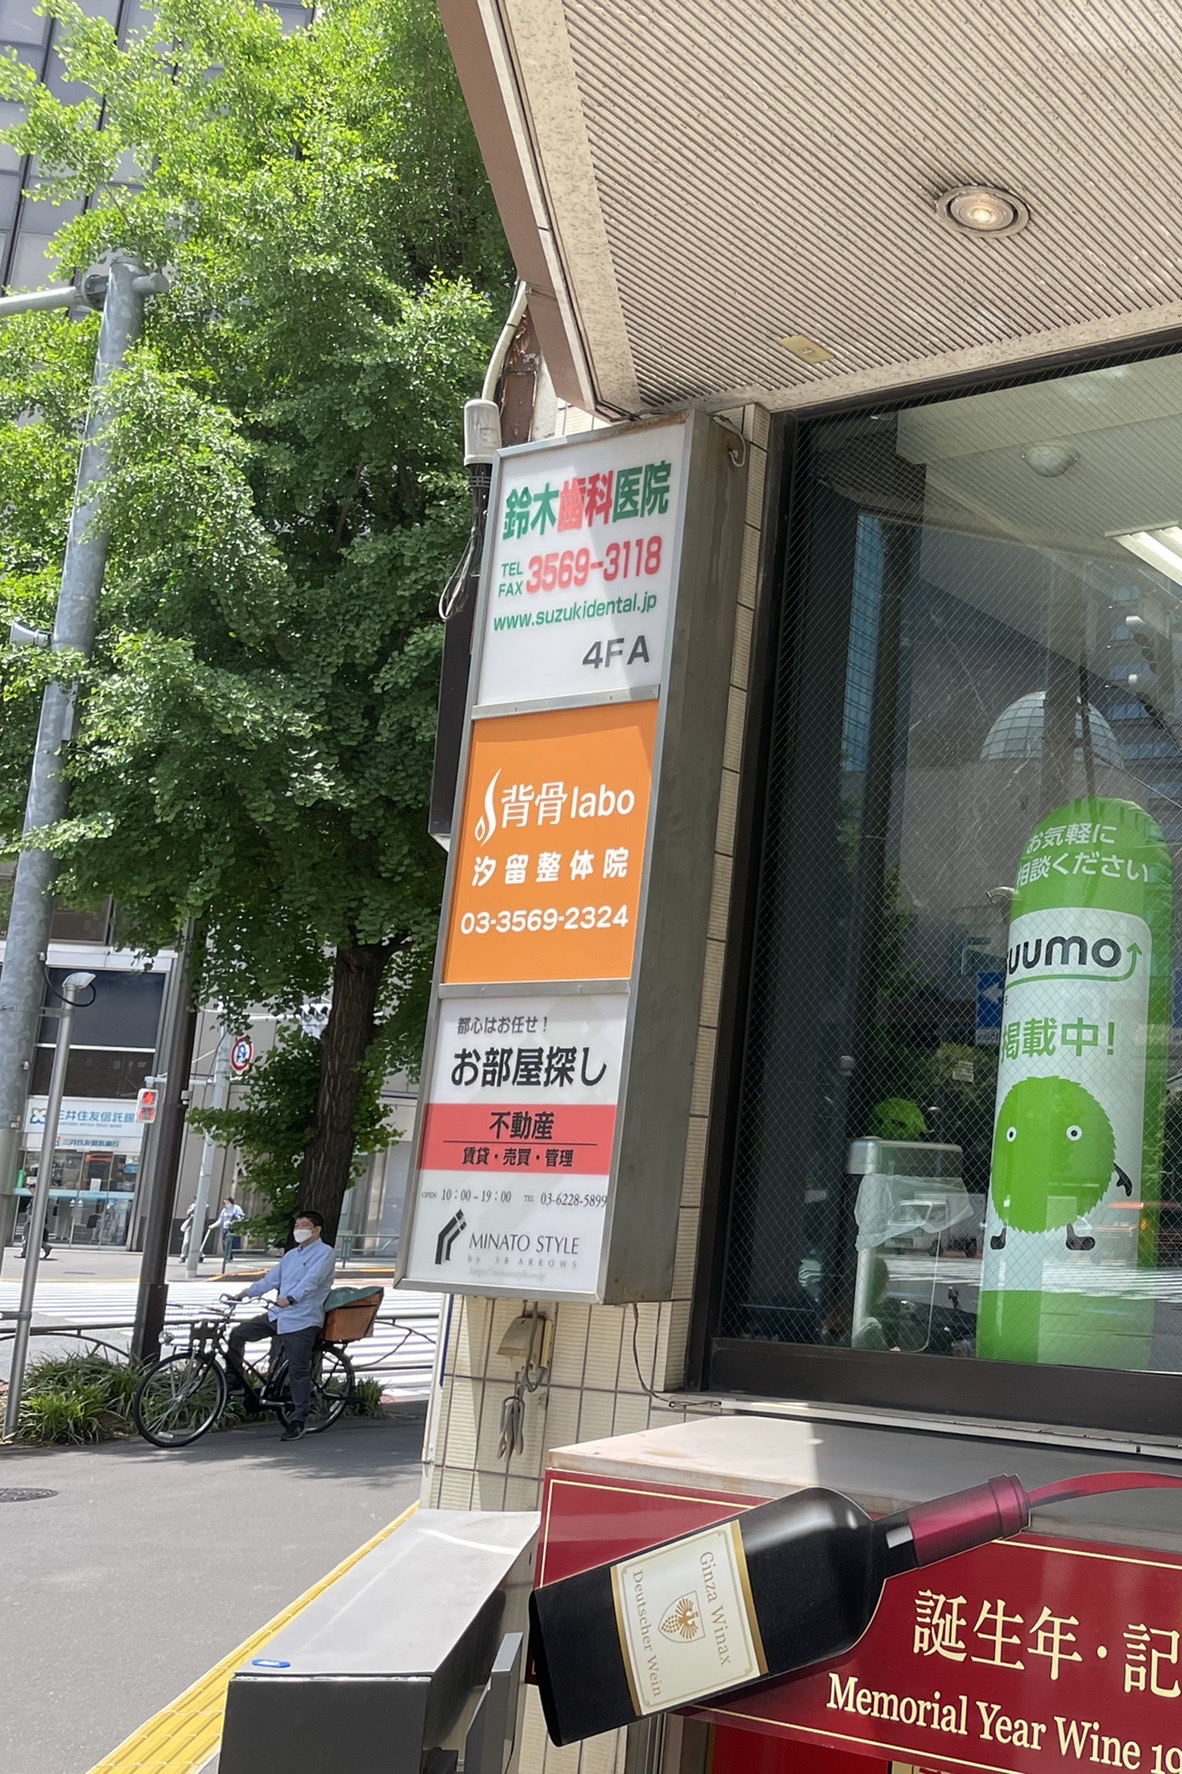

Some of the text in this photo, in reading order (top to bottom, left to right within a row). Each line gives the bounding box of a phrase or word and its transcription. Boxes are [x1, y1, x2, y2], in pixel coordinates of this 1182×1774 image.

[502, 461, 672, 540] 鈴木歯科医院
[501, 562, 523, 578] TEL
[526, 535, 663, 594] 3569-3118
[498, 580, 523, 598] FAX
[493, 591, 658, 631] www.suzukidental.jp
[1026, 823, 1117, 855] お気軽に
[471, 847, 630, 887] 汐留整体院
[460, 904, 630, 934] 03-3569-2324
[457, 1015, 549, 1035] 都心はお任せ！
[451, 1046, 608, 1087] お部屋探し
[58, 1110, 143, 1124] 三井住友信託銀
[489, 1111, 555, 1140] 不動産
[462, 1147, 574, 1168] 賃貸・売買・管理
[421, 1191, 437, 1199] OPEN
[524, 1194, 534, 1202] TEL
[540, 1192, 608, 1208] 03-6228-5899
[469, 1233, 580, 1255] MINATO STYLE
[467, 1255, 481, 1265] by
[518, 1258, 578, 1269] ARROWS
[699, 1551, 731, 1666] Ginza Winax
[632, 1570, 663, 1697] Deutscher Wein
[826, 1672, 968, 1735] Memorial
[975, 1700, 1047, 1750] Year
[1053, 1715, 1141, 1770] Wine
